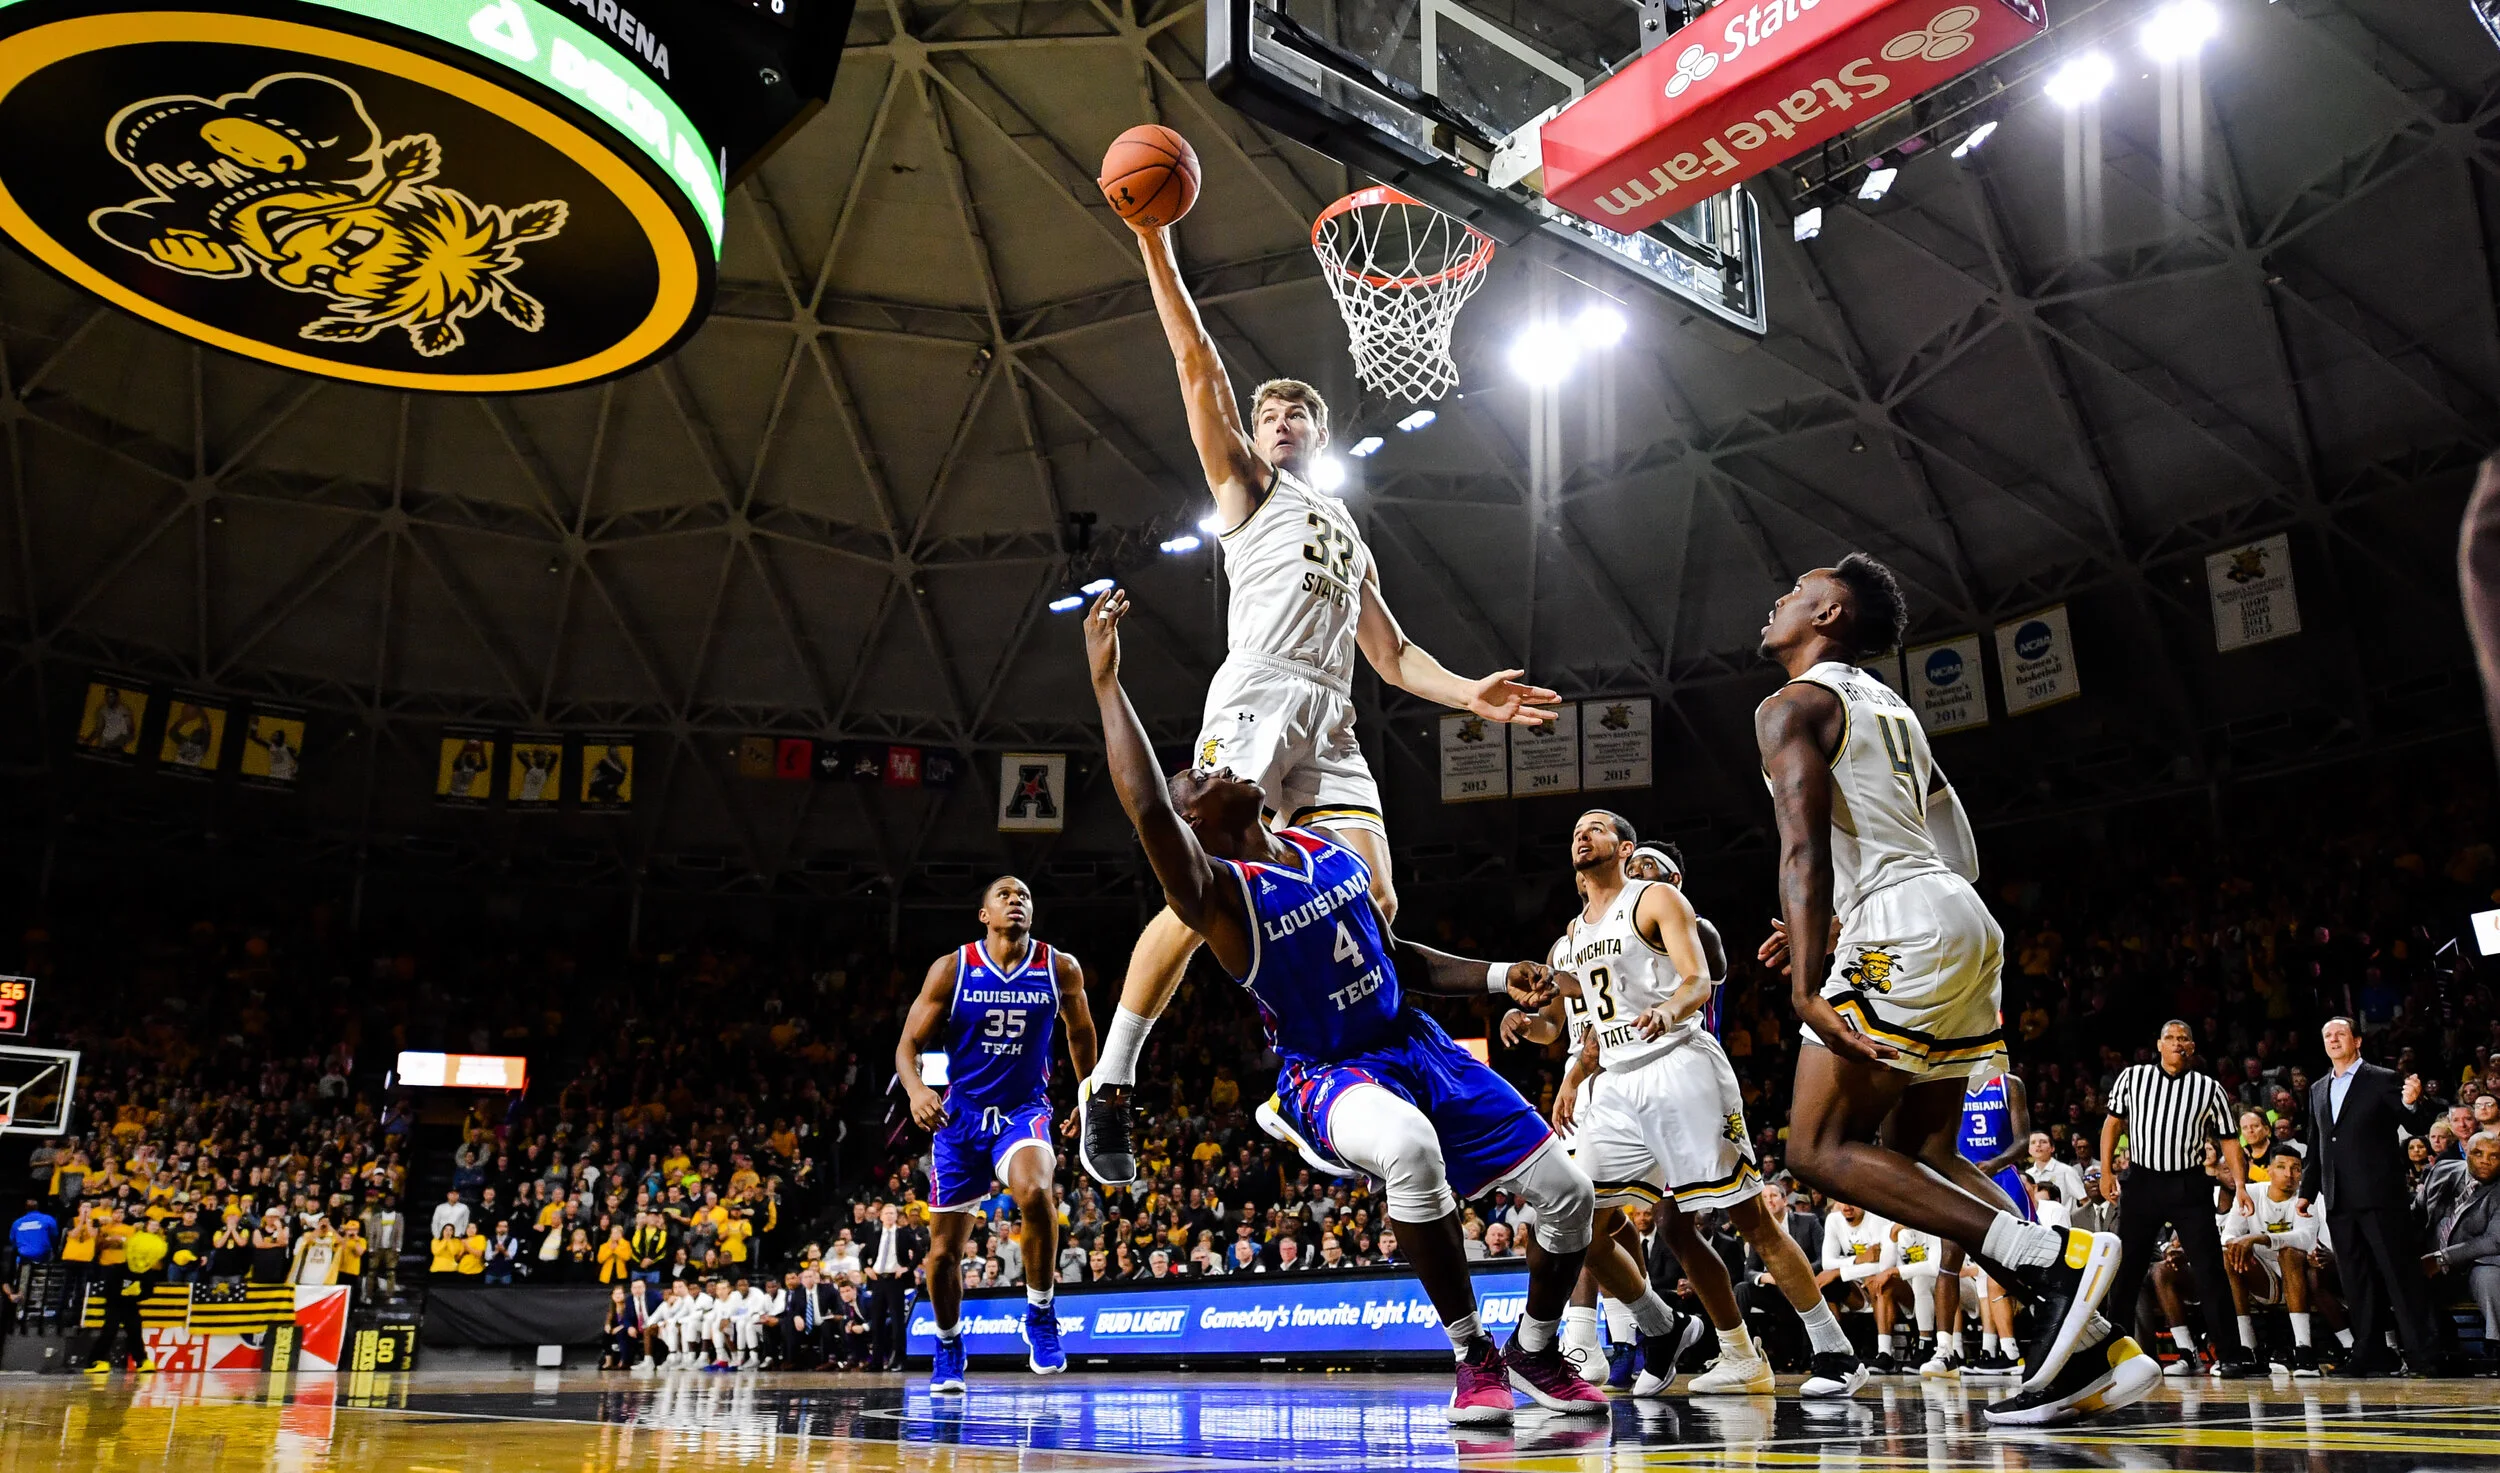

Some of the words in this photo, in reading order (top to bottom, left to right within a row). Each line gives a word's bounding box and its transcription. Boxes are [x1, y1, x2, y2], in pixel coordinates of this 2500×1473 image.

[146, 158, 255, 189] WSU
[1303, 512, 1354, 585] 33
[1302, 572, 1346, 608] STATE
[2020, 634, 2052, 656] NCAA
[1930, 663, 1962, 680] NCAA
[2016, 654, 2059, 673] Women's
[2016, 663, 2062, 685] Basketball
[1925, 691, 1972, 709] Basketball
[1926, 682, 1969, 698] Women's
[1935, 708, 1967, 724] 2014
[1604, 769, 1631, 782] 2015
[1875, 714, 1924, 818] 4
[1461, 780, 1488, 793] 2013
[1532, 774, 1559, 787] 2014
[1264, 871, 1370, 941] LOUISIANA
[1333, 920, 1365, 968] 4
[1574, 938, 1622, 969] WICHITA
[963, 989, 1050, 1004] LOUISIANA
[1328, 965, 1384, 1011] TECH
[1590, 966, 1618, 1023] 3
[984, 1009, 1027, 1038] 35
[1599, 1024, 1634, 1049] TATE
[981, 1041, 1023, 1055] TECH
[1971, 1113, 1987, 1134] 3
[1967, 1137, 1997, 1146] TECH
[972, 1314, 1019, 1334] favorite
[1095, 1311, 1133, 1333] BUD
[1131, 1310, 1186, 1332] LIGHT
[1200, 1304, 1290, 1332] Gameday's
[1291, 1302, 1360, 1327] favorite
[1361, 1299, 1406, 1329] light
[376, 1337, 395, 1363] GO
